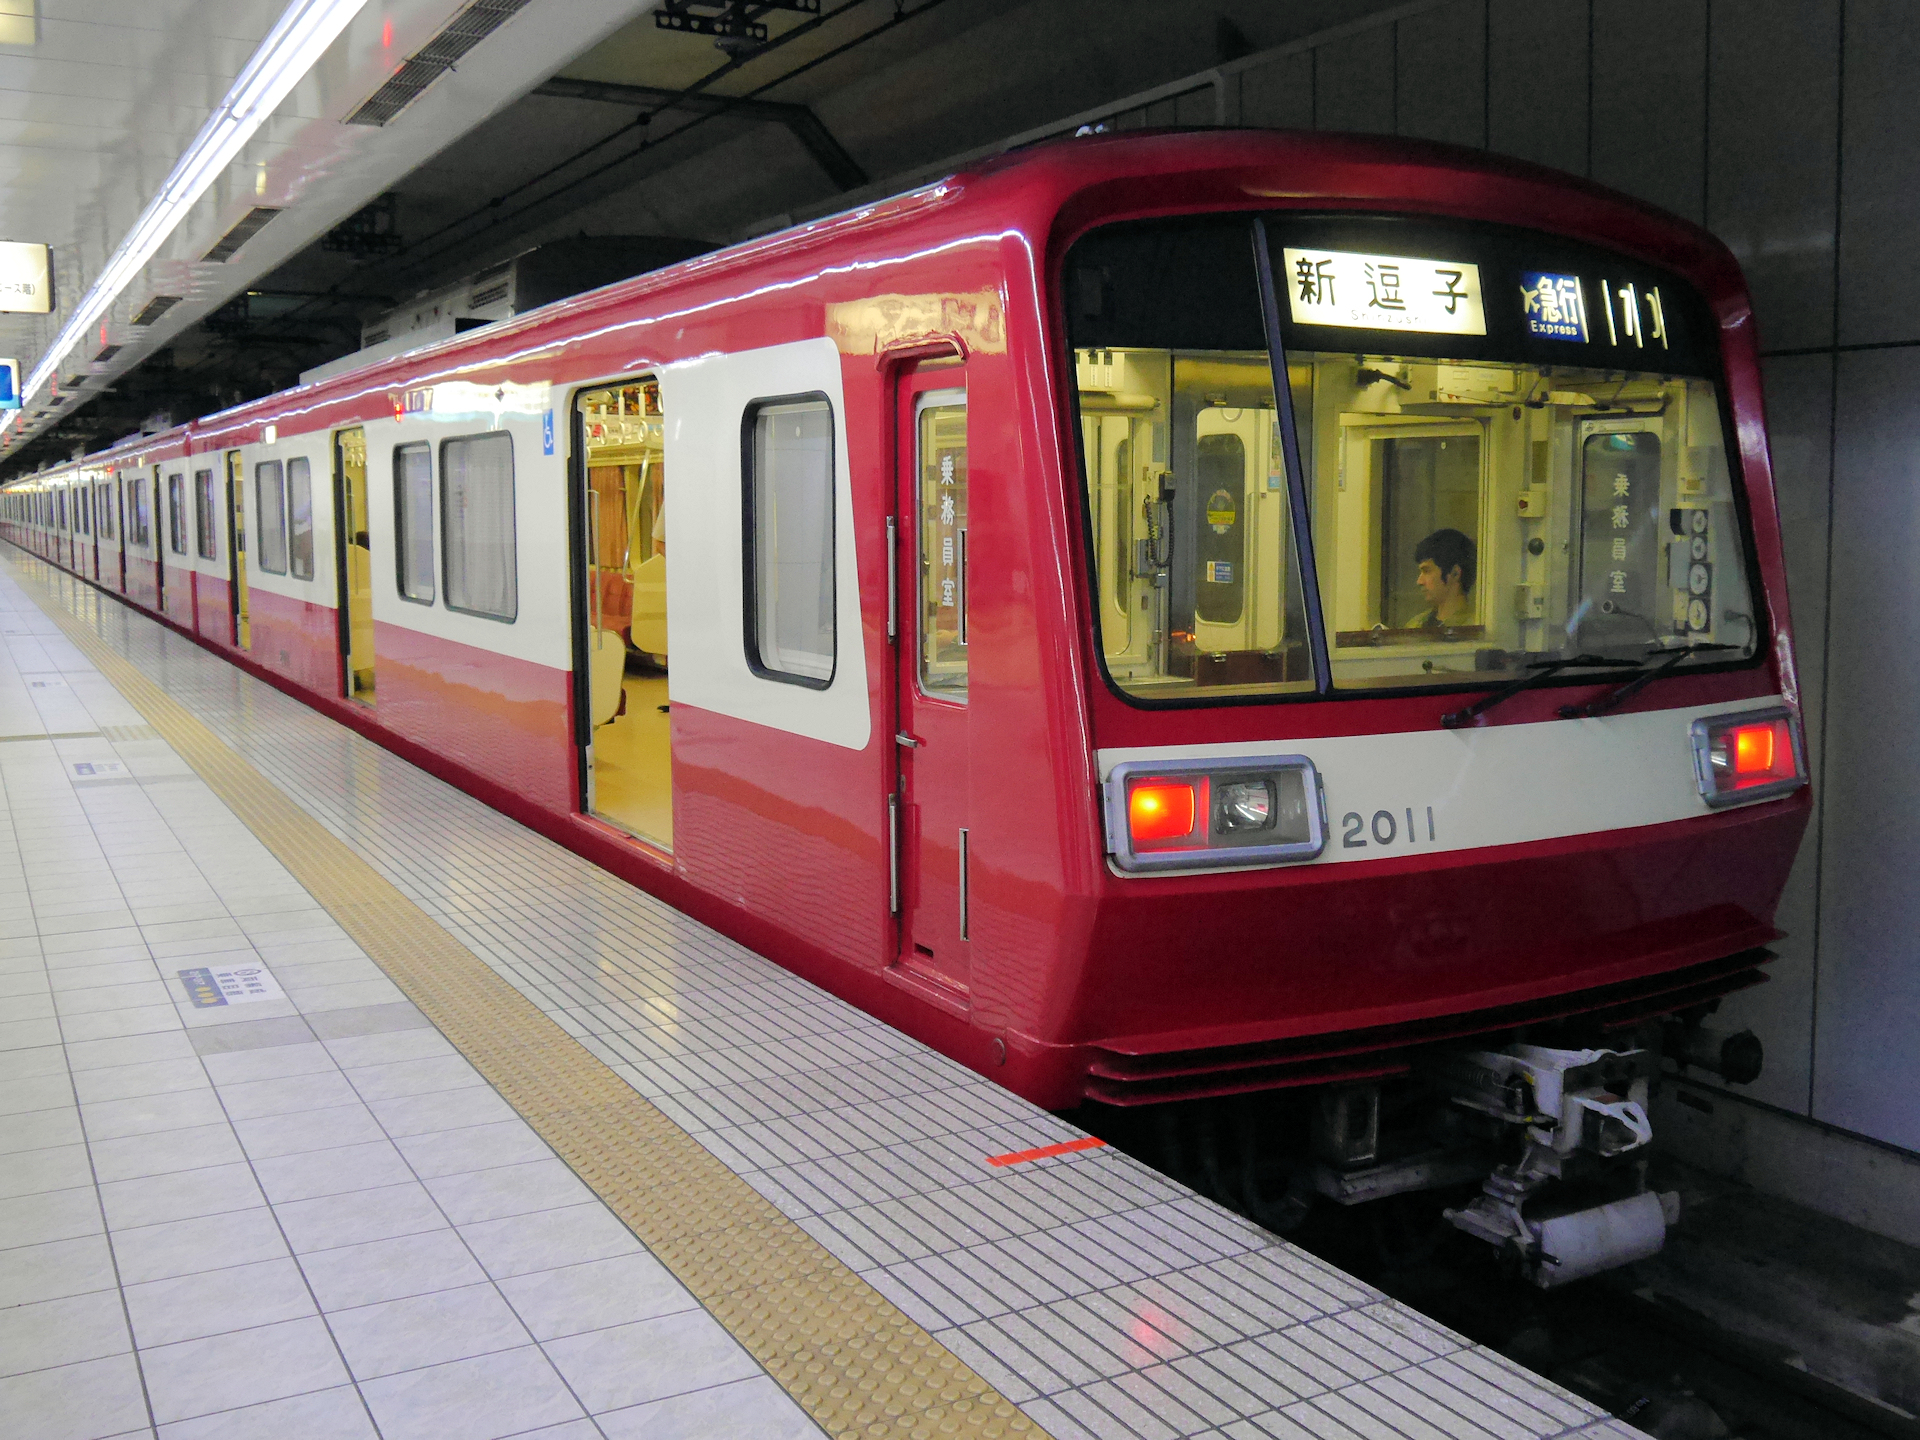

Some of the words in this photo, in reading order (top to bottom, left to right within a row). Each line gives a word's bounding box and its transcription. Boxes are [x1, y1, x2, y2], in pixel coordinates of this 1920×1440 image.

[0, 283, 36, 296] ース階)
[1296, 258, 1469, 314] 新逗子
[1537, 276, 1579, 324] 急行
[1530, 320, 1578, 336] Express
[940, 455, 955, 607] 乗務員室
[1342, 806, 1436, 849] 2011
